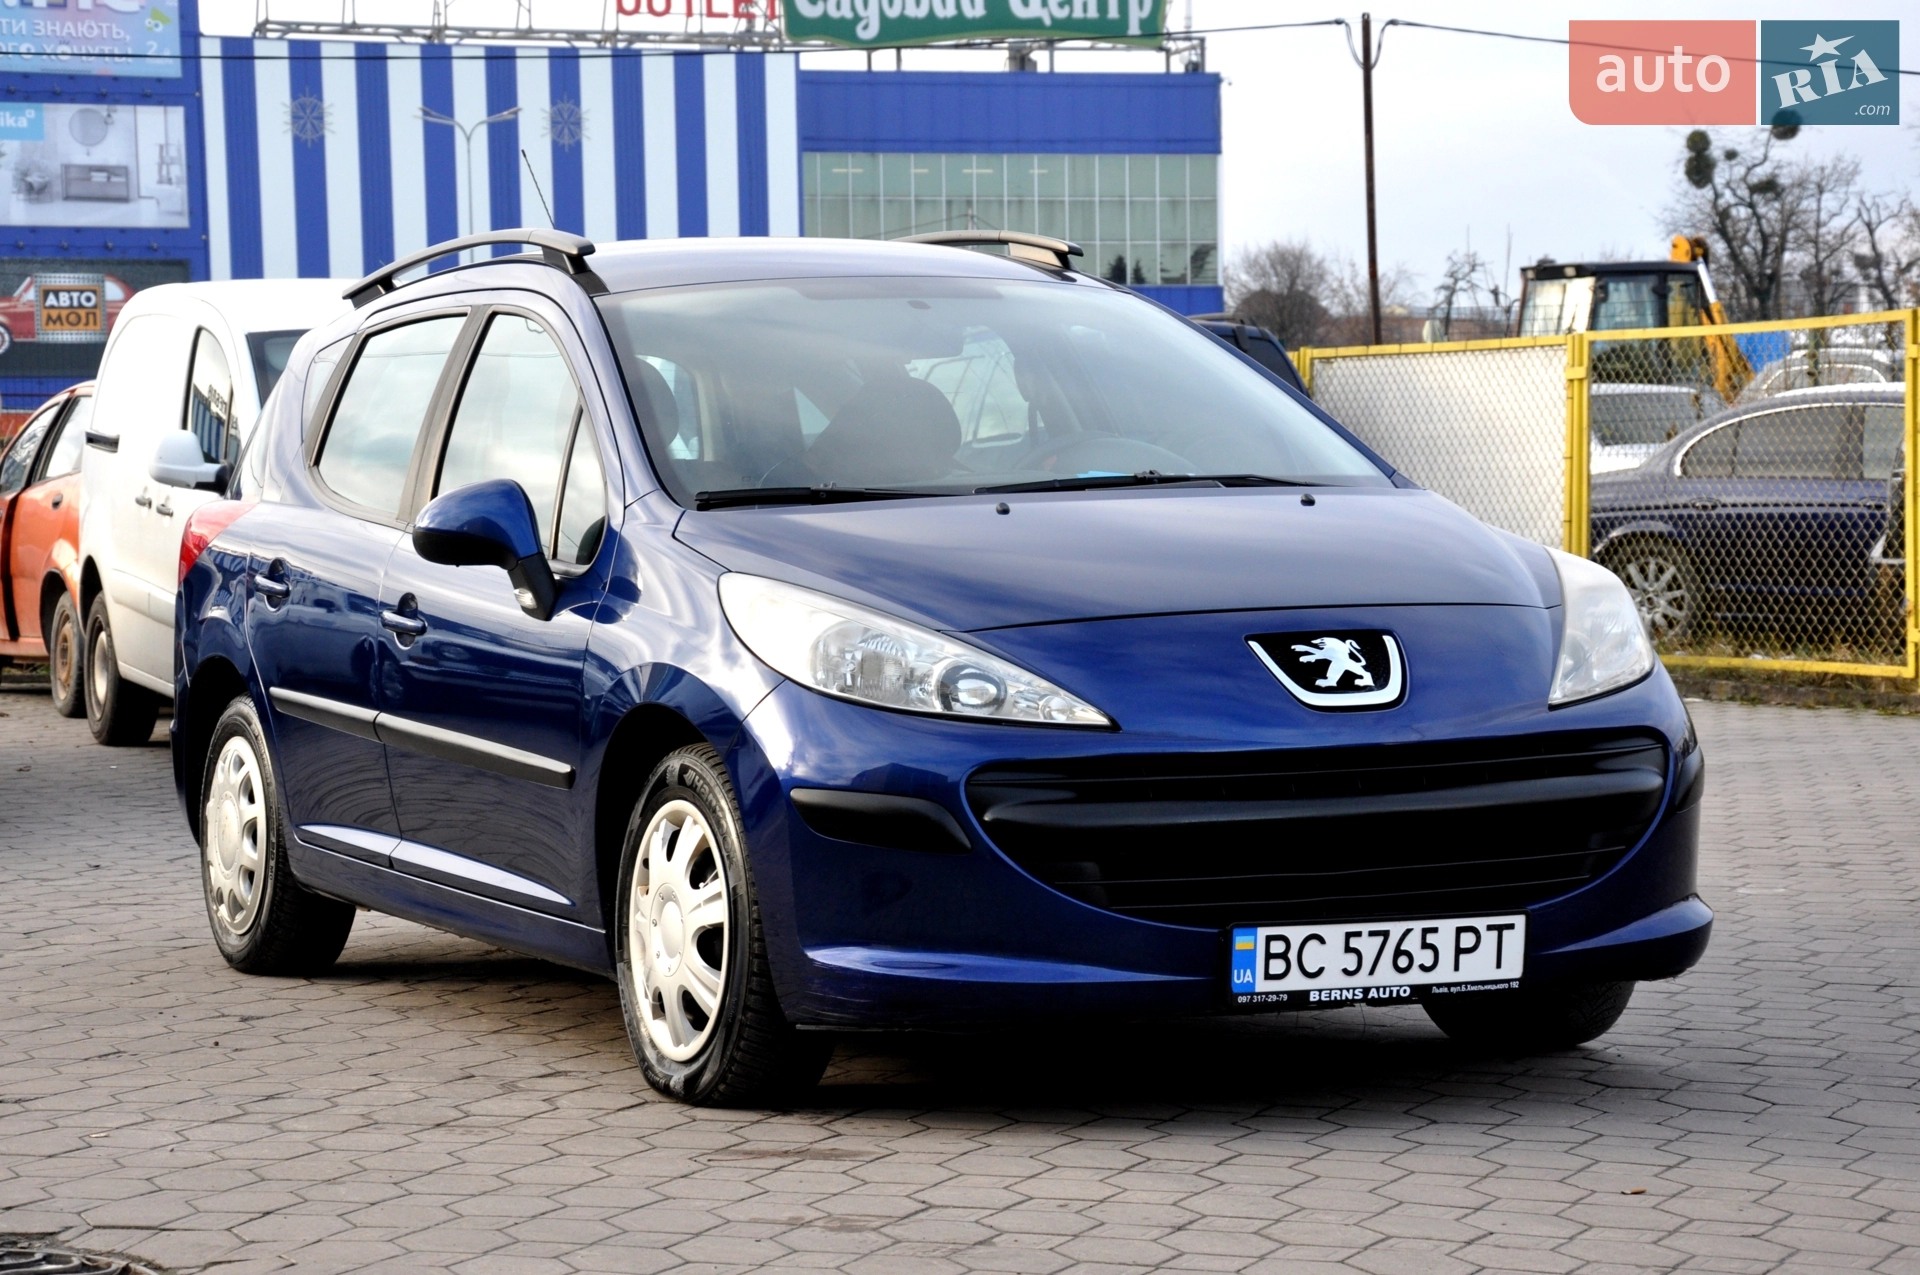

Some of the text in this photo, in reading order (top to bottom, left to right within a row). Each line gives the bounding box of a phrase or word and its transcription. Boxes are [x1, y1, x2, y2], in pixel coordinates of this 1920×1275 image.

[33, 19, 131, 43] ЗНАЮТЬ,
[44, 290, 97, 308] АВТО
[44, 311, 97, 327] МОЛ
[1263, 922, 1516, 981] BC 5765 PT
[1233, 969, 1254, 984] UA
[1237, 993, 1288, 1003] 097 317-29-79
[1309, 986, 1411, 1002] BERNS AUTO
